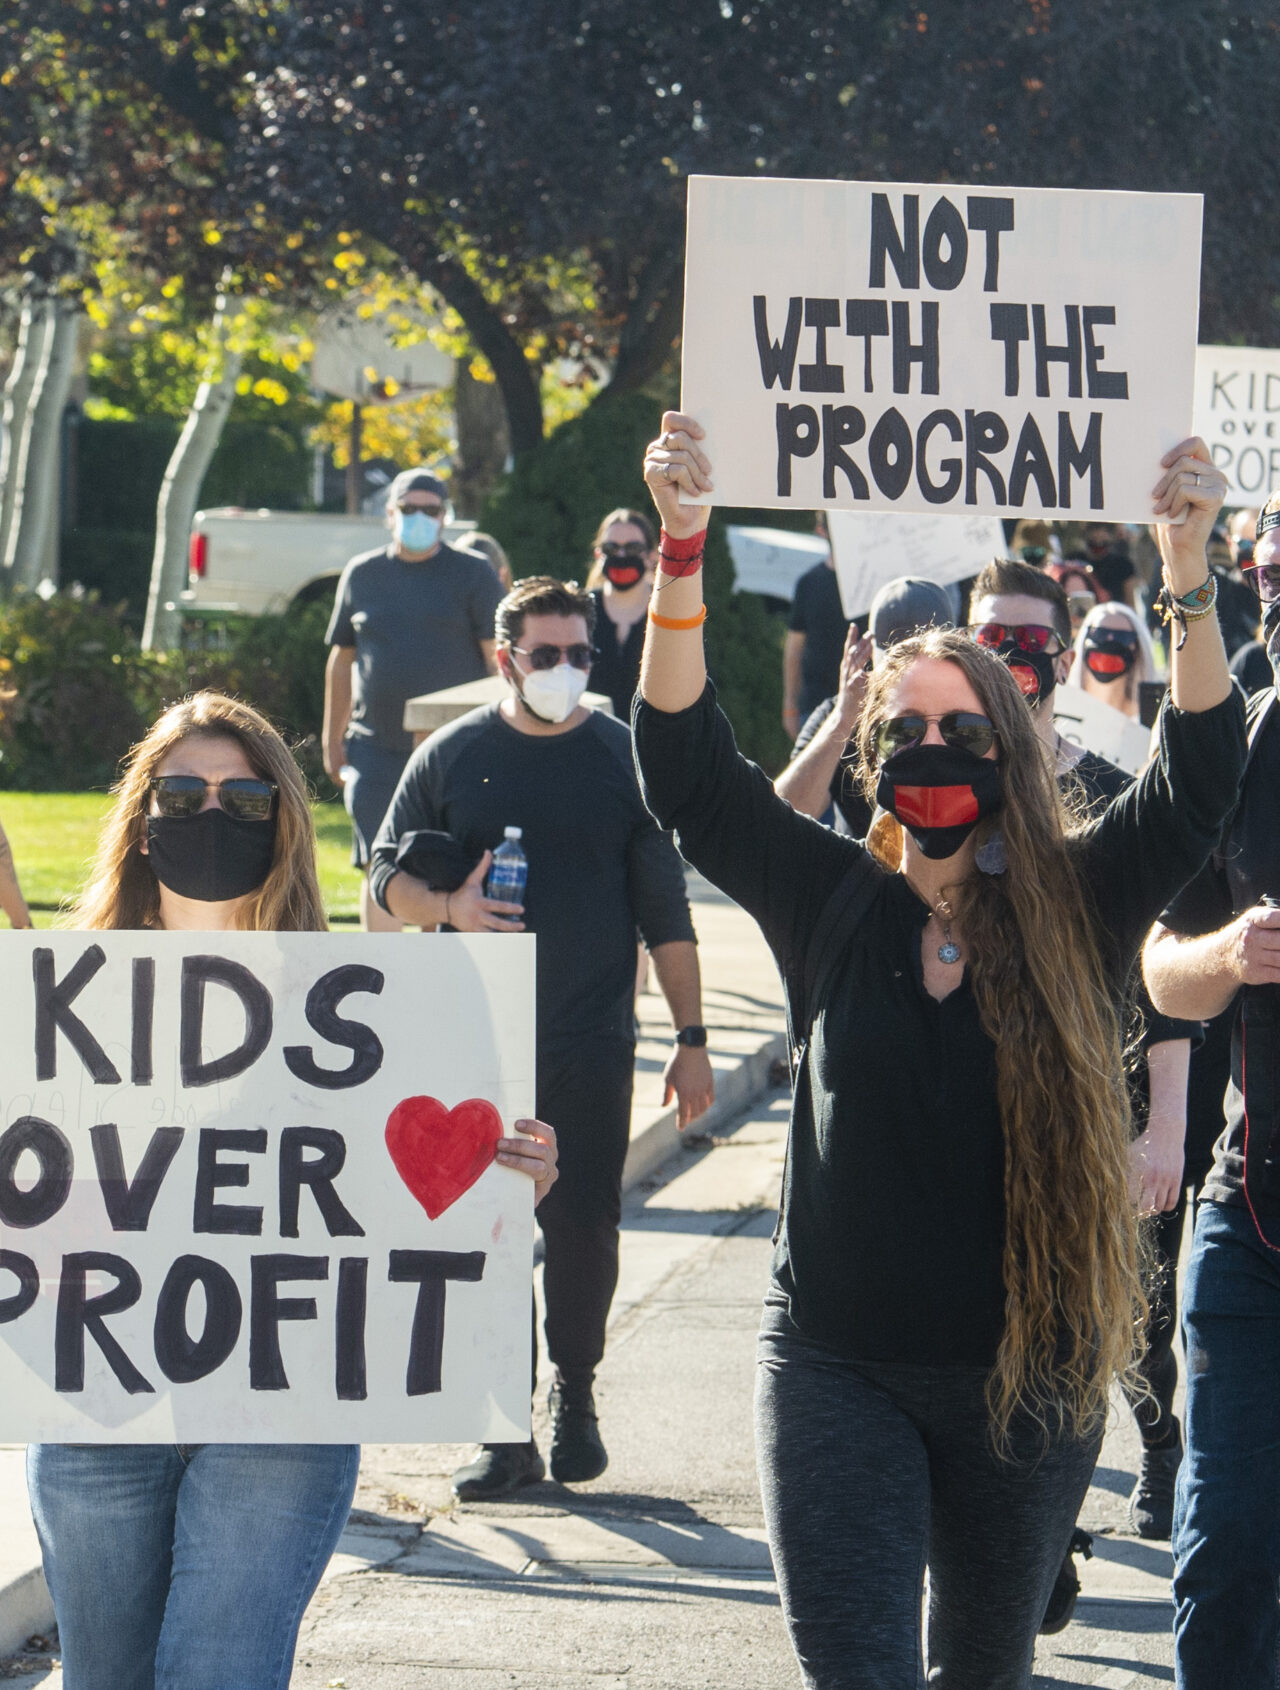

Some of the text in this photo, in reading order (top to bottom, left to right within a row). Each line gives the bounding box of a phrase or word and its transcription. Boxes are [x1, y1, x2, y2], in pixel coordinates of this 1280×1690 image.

[869, 193, 1014, 292] NOT
[753, 295, 1129, 400] WITH THE
[776, 403, 1103, 510] PROGRAM
[32, 943, 384, 1090] KIDS
